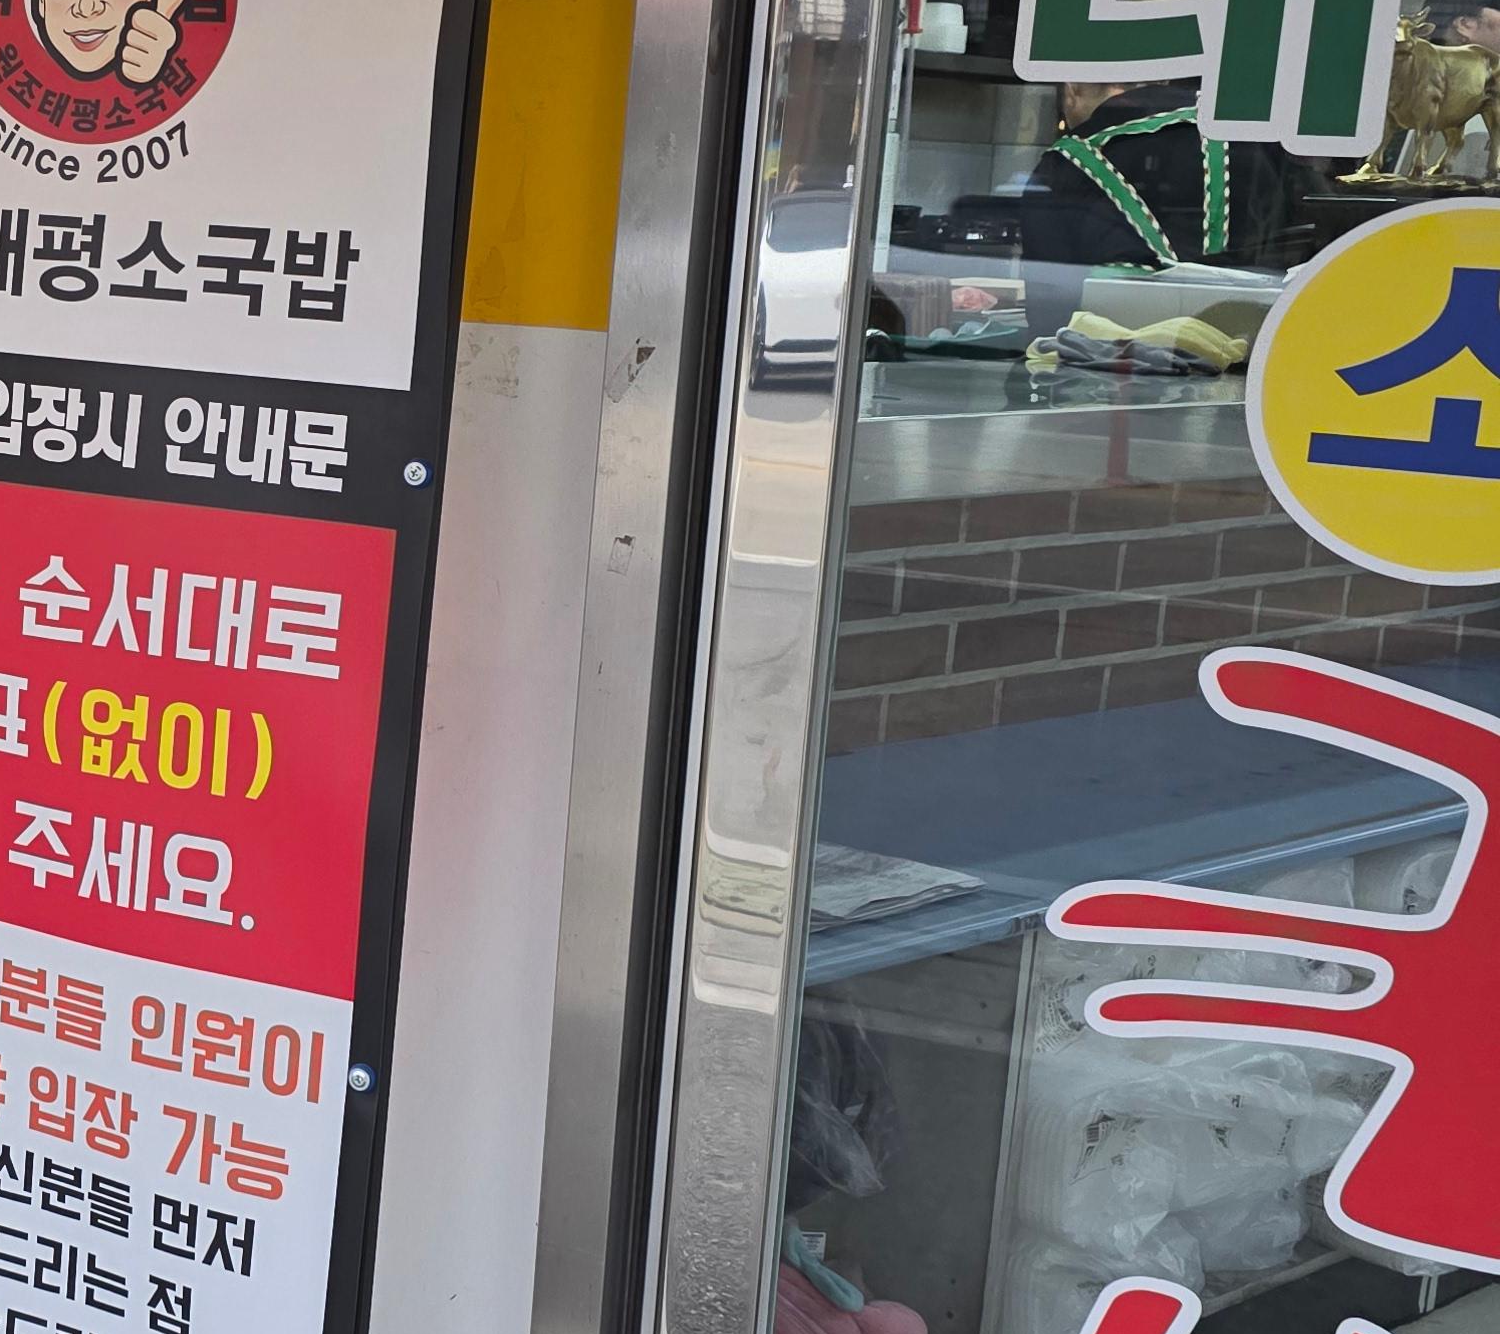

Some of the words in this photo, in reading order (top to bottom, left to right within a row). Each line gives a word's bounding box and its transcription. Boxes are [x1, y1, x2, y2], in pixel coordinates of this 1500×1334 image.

[96, 120, 191, 184] 2007
[163, 394, 349, 495] 안내문
[17, 554, 343, 681] 순서대로
[7, 799, 257, 932] 주세요.
[129, 995, 325, 1104] 인원이
[28, 1065, 139, 1161] 입장
[161, 1105, 292, 1202] 가능
[151, 1201, 257, 1277] 먼저
